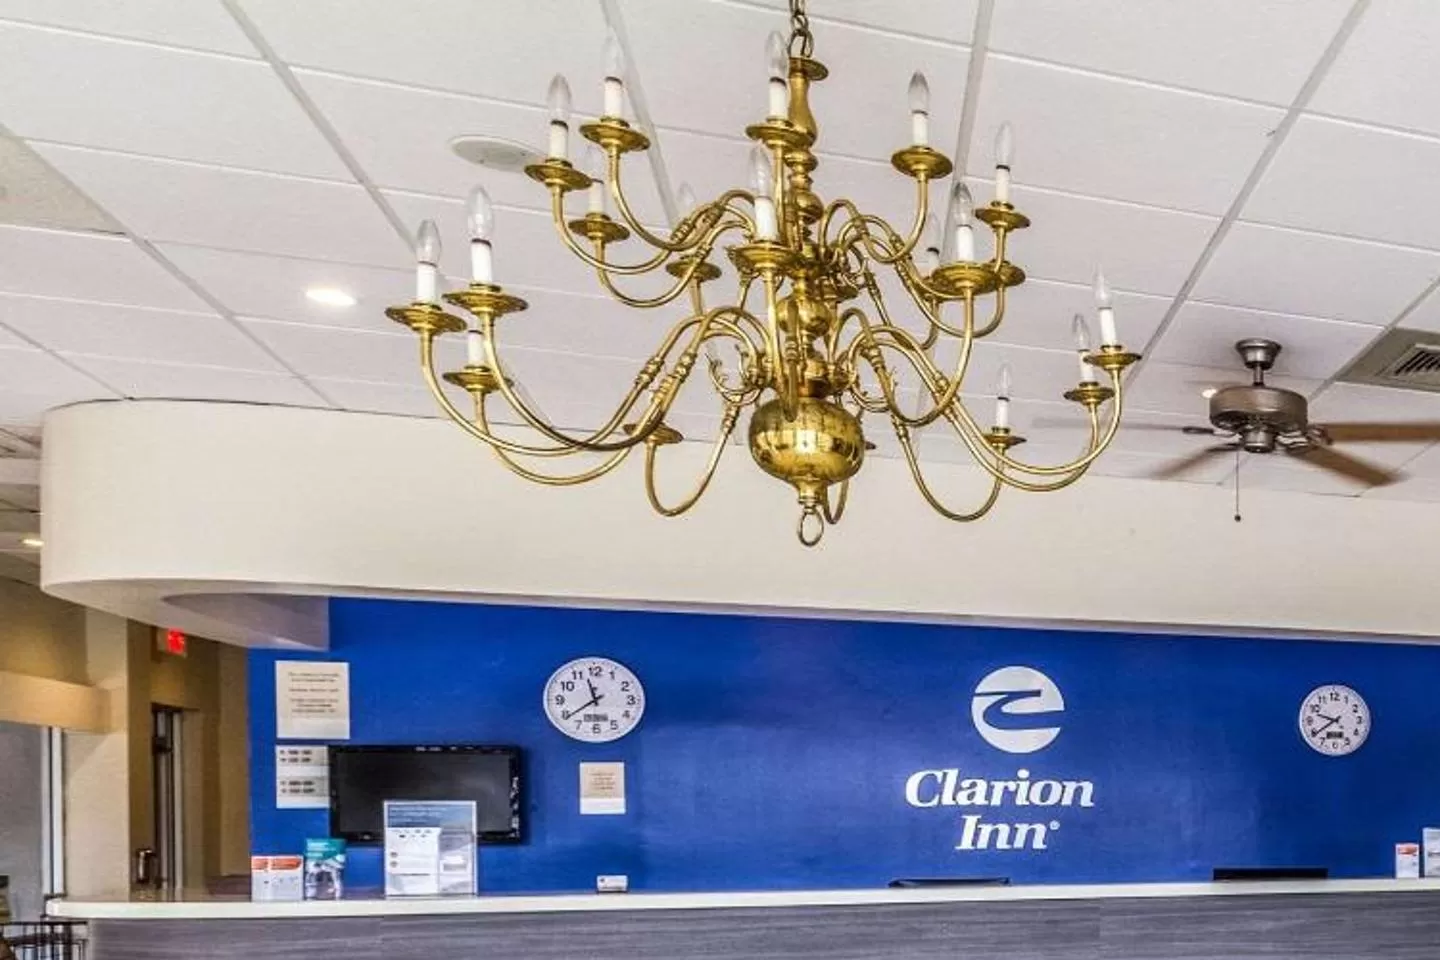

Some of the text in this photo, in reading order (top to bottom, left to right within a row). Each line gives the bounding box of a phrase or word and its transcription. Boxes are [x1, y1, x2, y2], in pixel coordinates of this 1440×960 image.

[572, 670, 583, 680] 11
[588, 666, 602, 677] 12
[609, 670, 615, 680] 1
[561, 681, 575, 692] 10
[621, 681, 630, 692] 2
[555, 694, 565, 705] 9
[627, 695, 636, 706] 3
[1330, 692, 1340, 701] 12
[574, 720, 582, 730] 7
[592, 723, 601, 734] 6
[610, 720, 619, 730] 5
[905, 768, 1095, 808] Clarion
